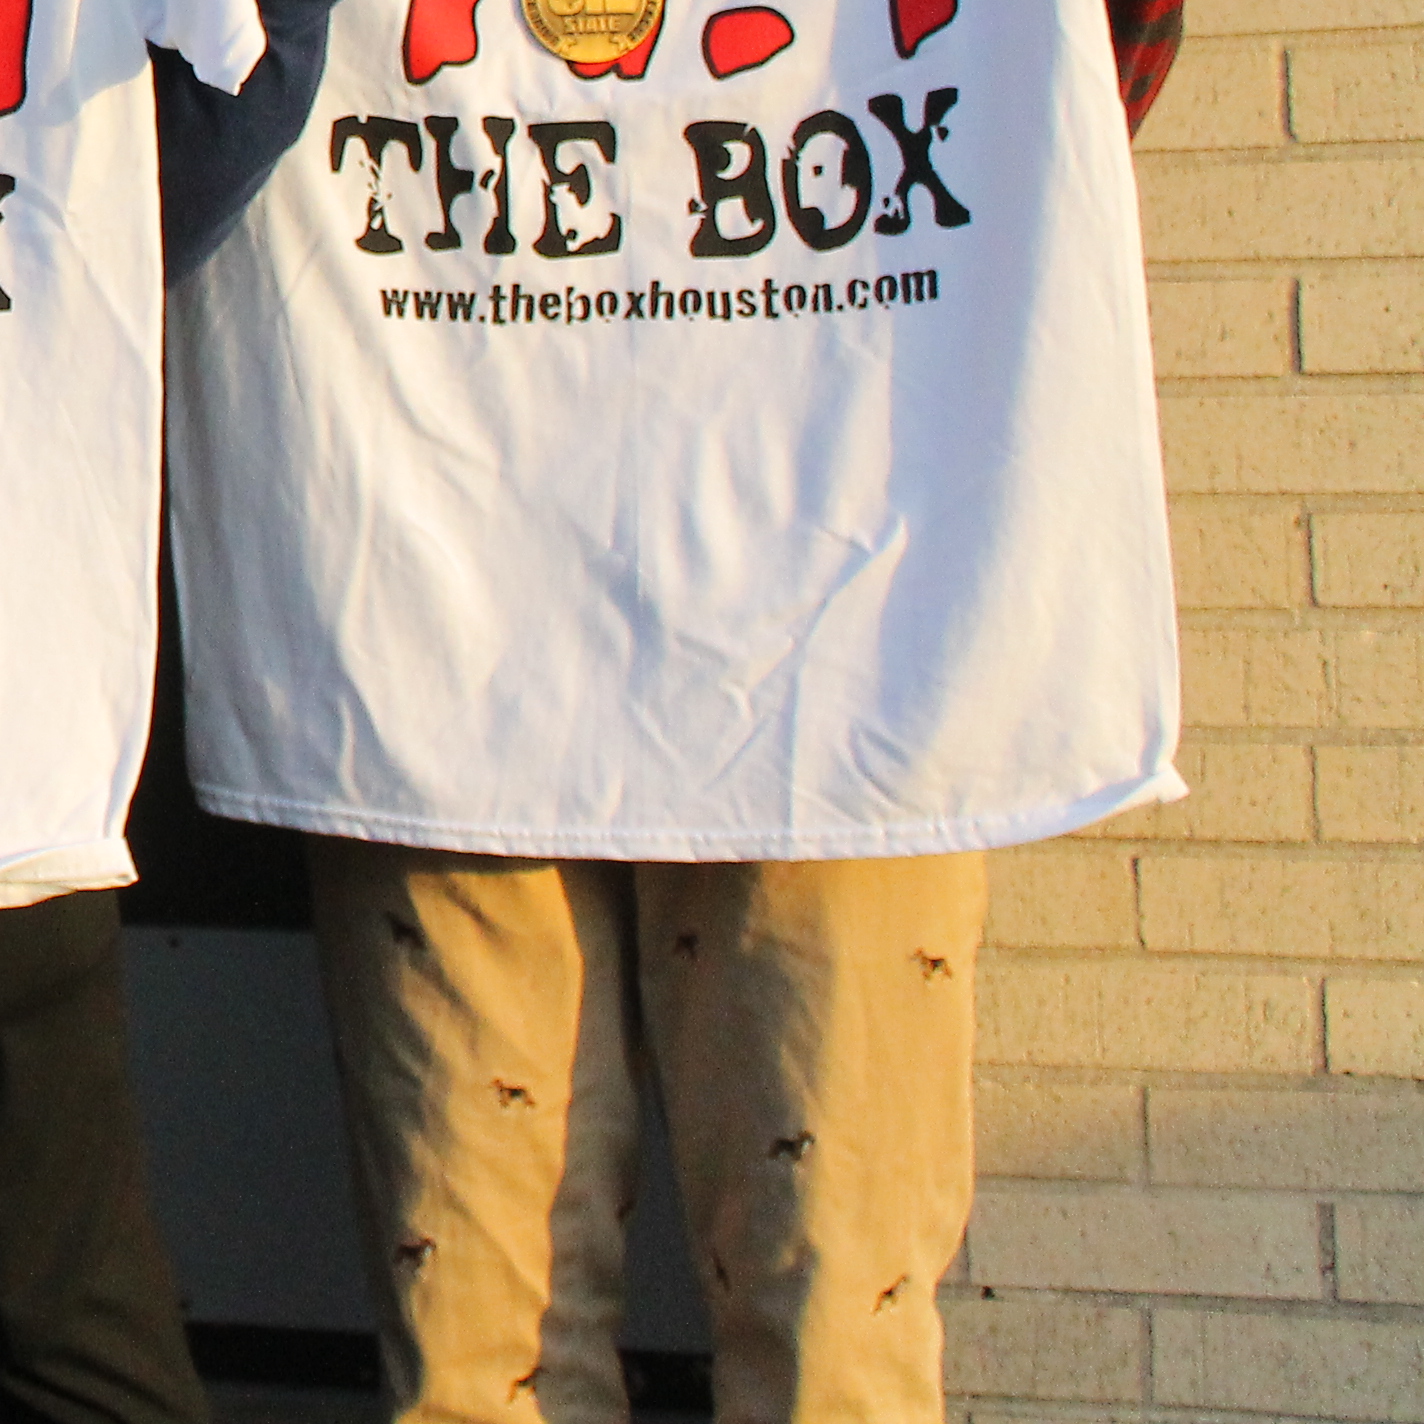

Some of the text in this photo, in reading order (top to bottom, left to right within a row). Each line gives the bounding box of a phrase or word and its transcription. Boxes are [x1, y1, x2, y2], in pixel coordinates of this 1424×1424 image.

[330, 87, 972, 259] THE BOX
[378, 267, 939, 325] www.theboxhouston.com
